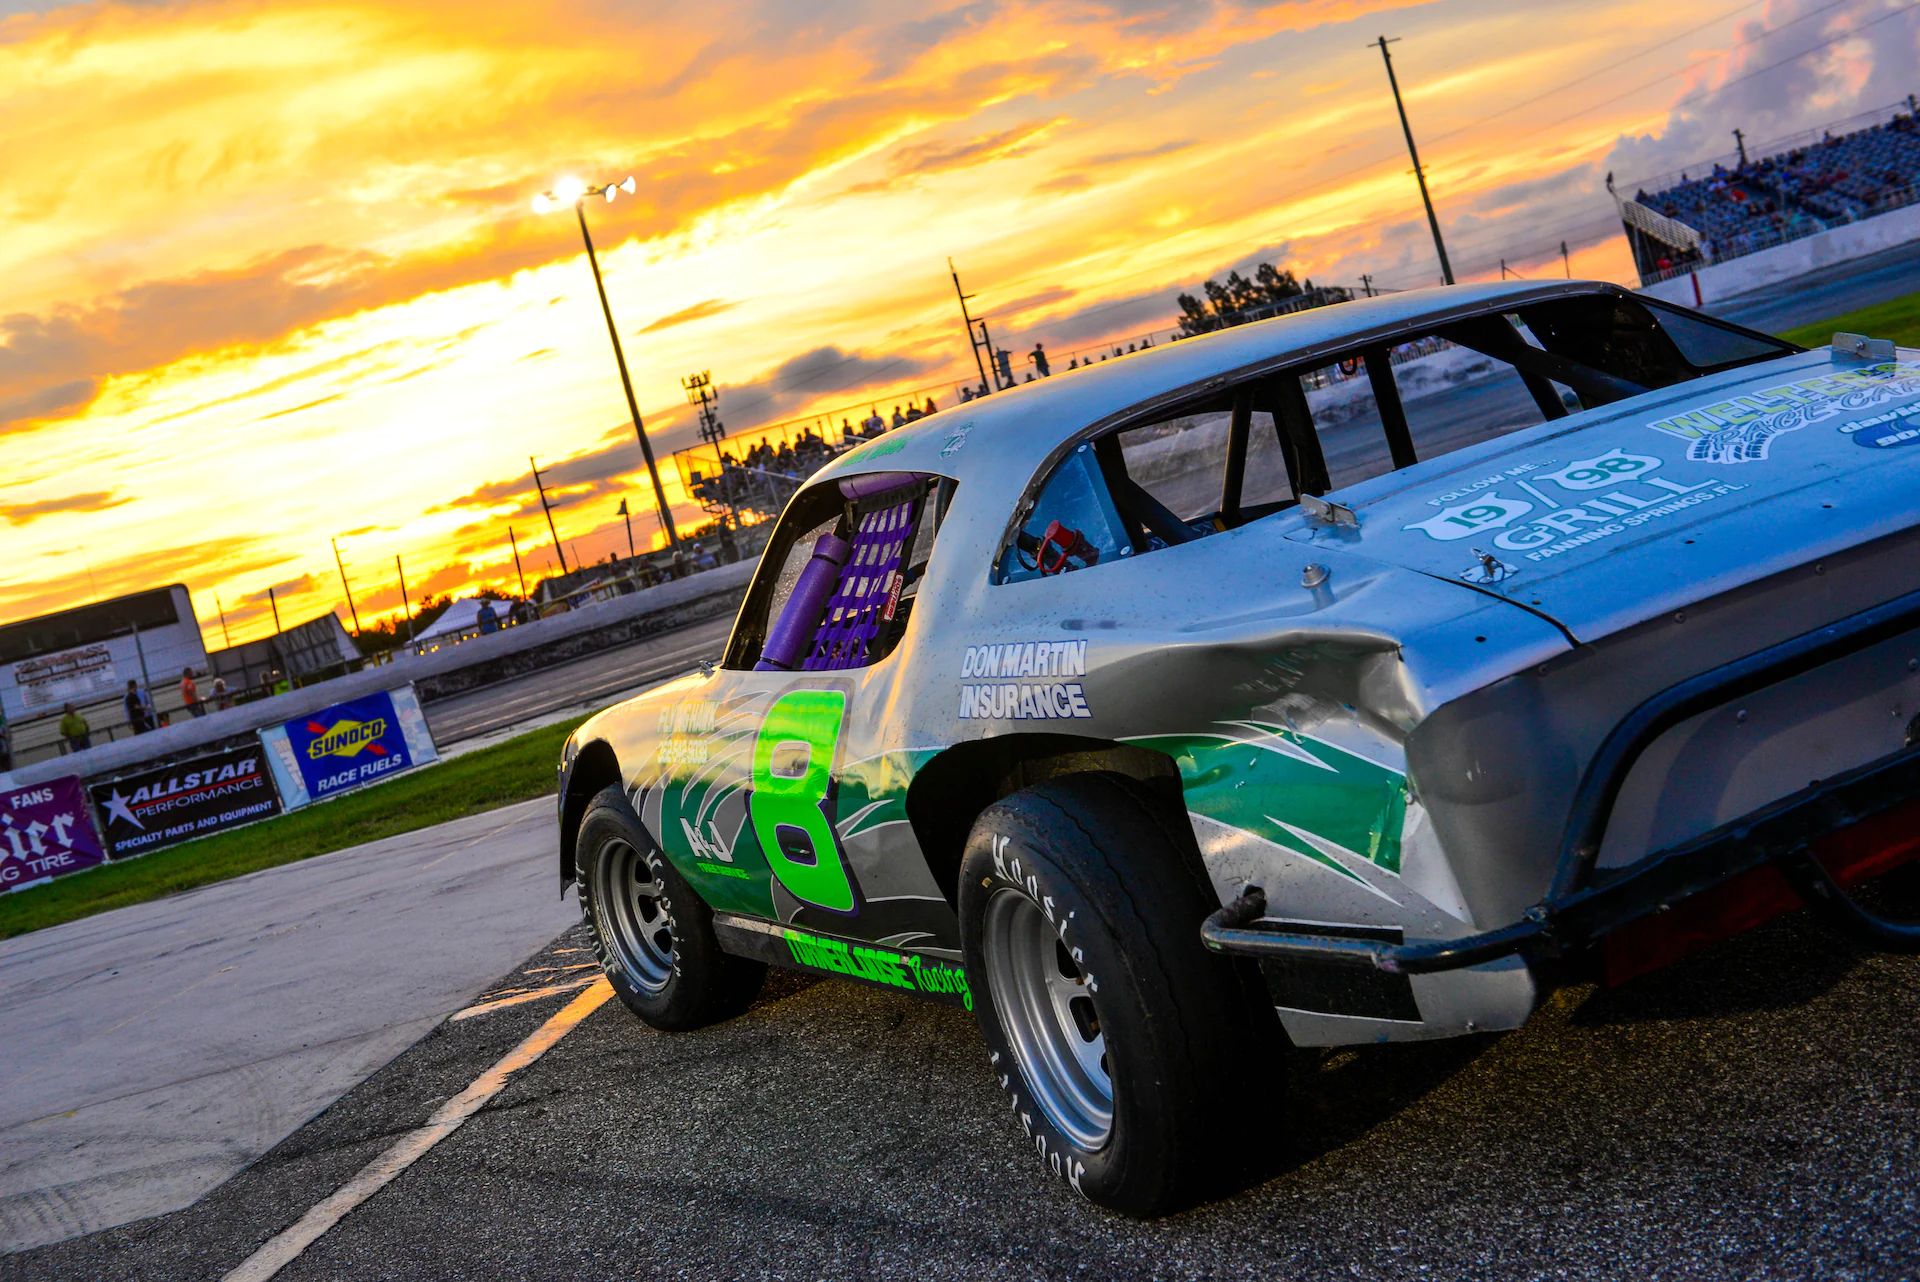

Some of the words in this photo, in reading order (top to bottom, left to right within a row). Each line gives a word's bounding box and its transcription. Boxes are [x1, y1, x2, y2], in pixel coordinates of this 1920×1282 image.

[1710, 400, 1838, 452] RACE
[1427, 474, 1506, 507] FOLLOW
[1444, 505, 1507, 530] 19
[1565, 457, 1647, 485] 98
[1492, 476, 1722, 551] GRILL
[1524, 523, 1627, 562] FANNING
[960, 643, 1005, 680] DON
[1000, 639, 1089, 679] MARTIN
[958, 682, 1094, 720] INSURANCE
[313, 720, 382, 757] SUNOCO
[130, 758, 257, 805] ALLSTAR
[318, 768, 357, 792] RACE
[360, 754, 402, 778] FUELS
[11, 788, 55, 810] FANS
[135, 776, 264, 819] PERFORMANCE
[750, 688, 857, 912] 8
[115, 831, 163, 851] SPECIALTY
[165, 822, 195, 837] PARTS
[197, 815, 218, 830] AND
[219, 800, 273, 823] EQUIPMENT
[25, 850, 76, 874] TIRE
[992, 832, 1099, 993] Hoosier
[908, 954, 973, 1012] Racing
